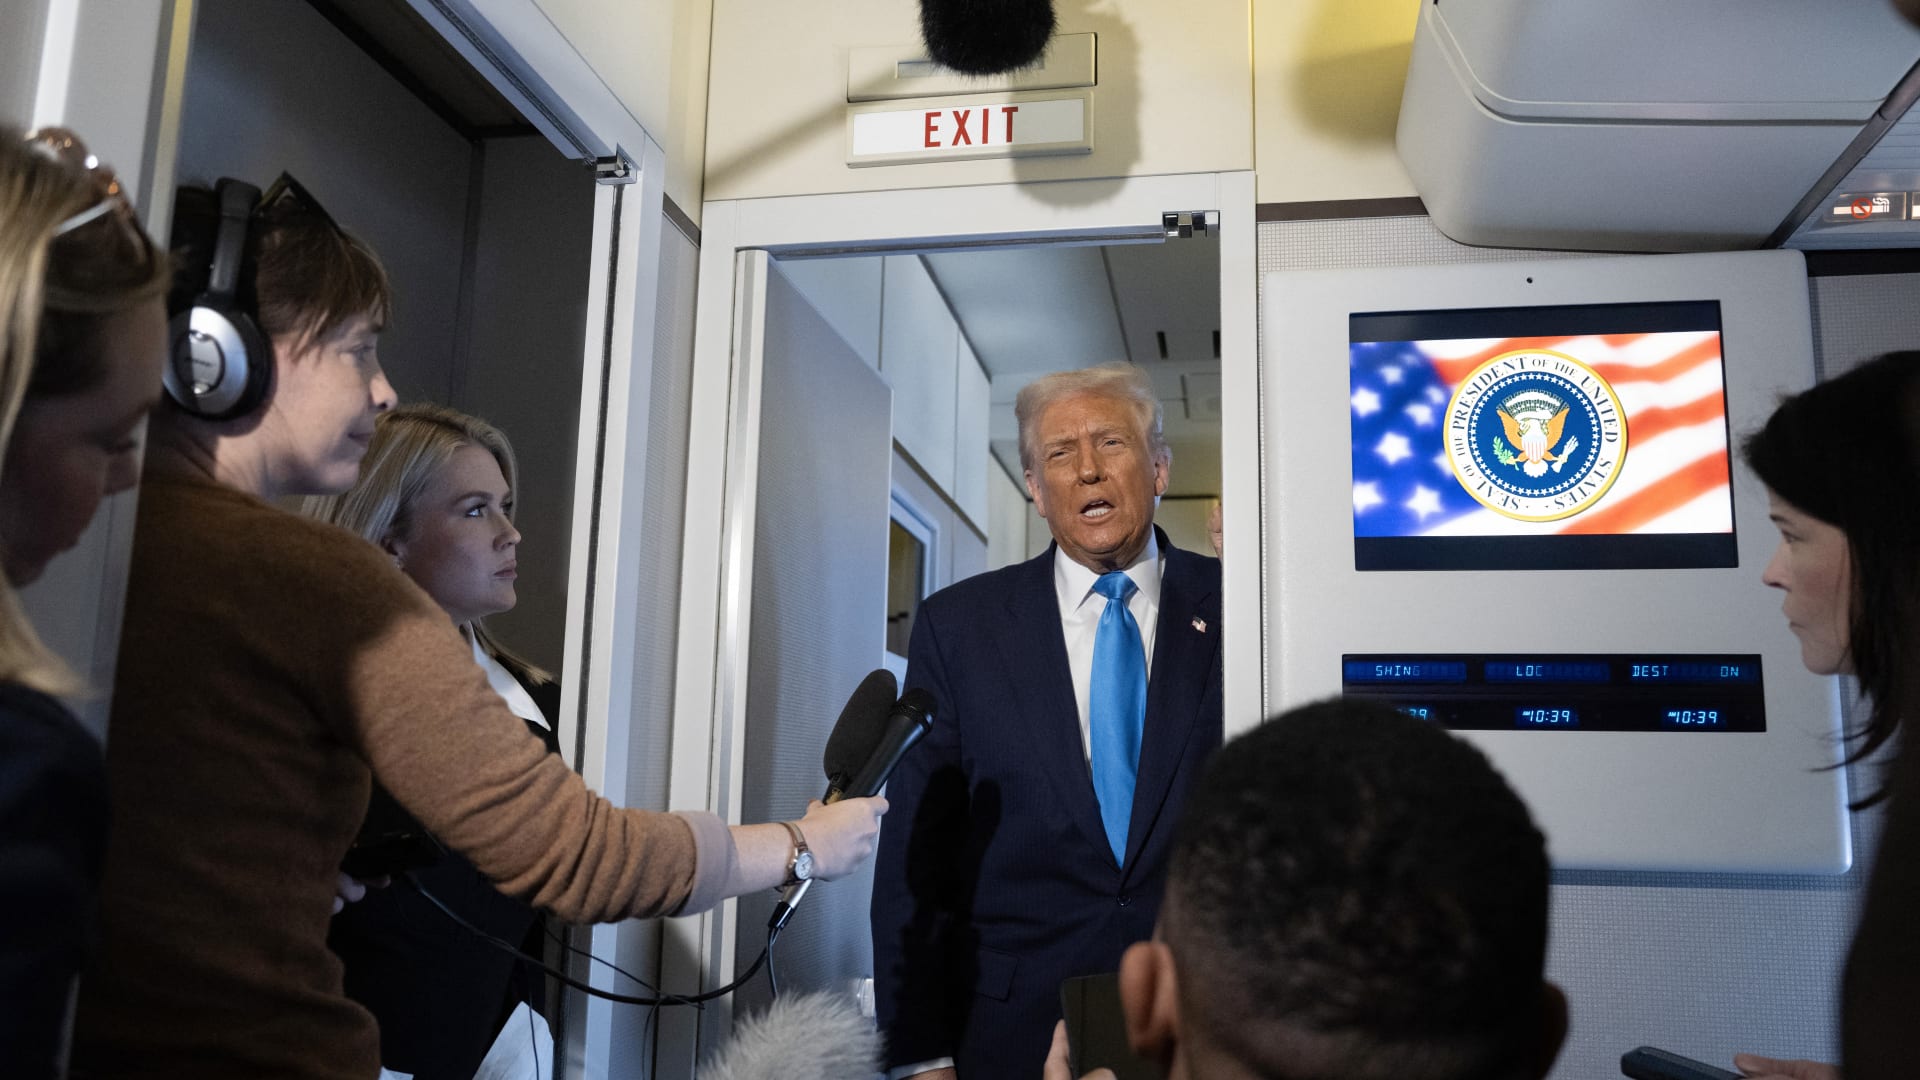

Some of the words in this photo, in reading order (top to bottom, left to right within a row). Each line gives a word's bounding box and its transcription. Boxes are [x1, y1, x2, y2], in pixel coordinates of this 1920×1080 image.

[924, 106, 1019, 149] EXIT
[1532, 357, 1548, 368] OF
[1553, 361, 1578, 377] THE
[1452, 356, 1528, 431] PRESIDENT
[1580, 375, 1618, 443] UNITED
[1453, 437, 1466, 457] THE
[1476, 476, 1521, 511] SEAL
[1554, 457, 1613, 510] STATES
[1632, 665, 1669, 677] DEST
[1720, 665, 1739, 677] ON
[1676, 711, 1718, 724] 10:39
